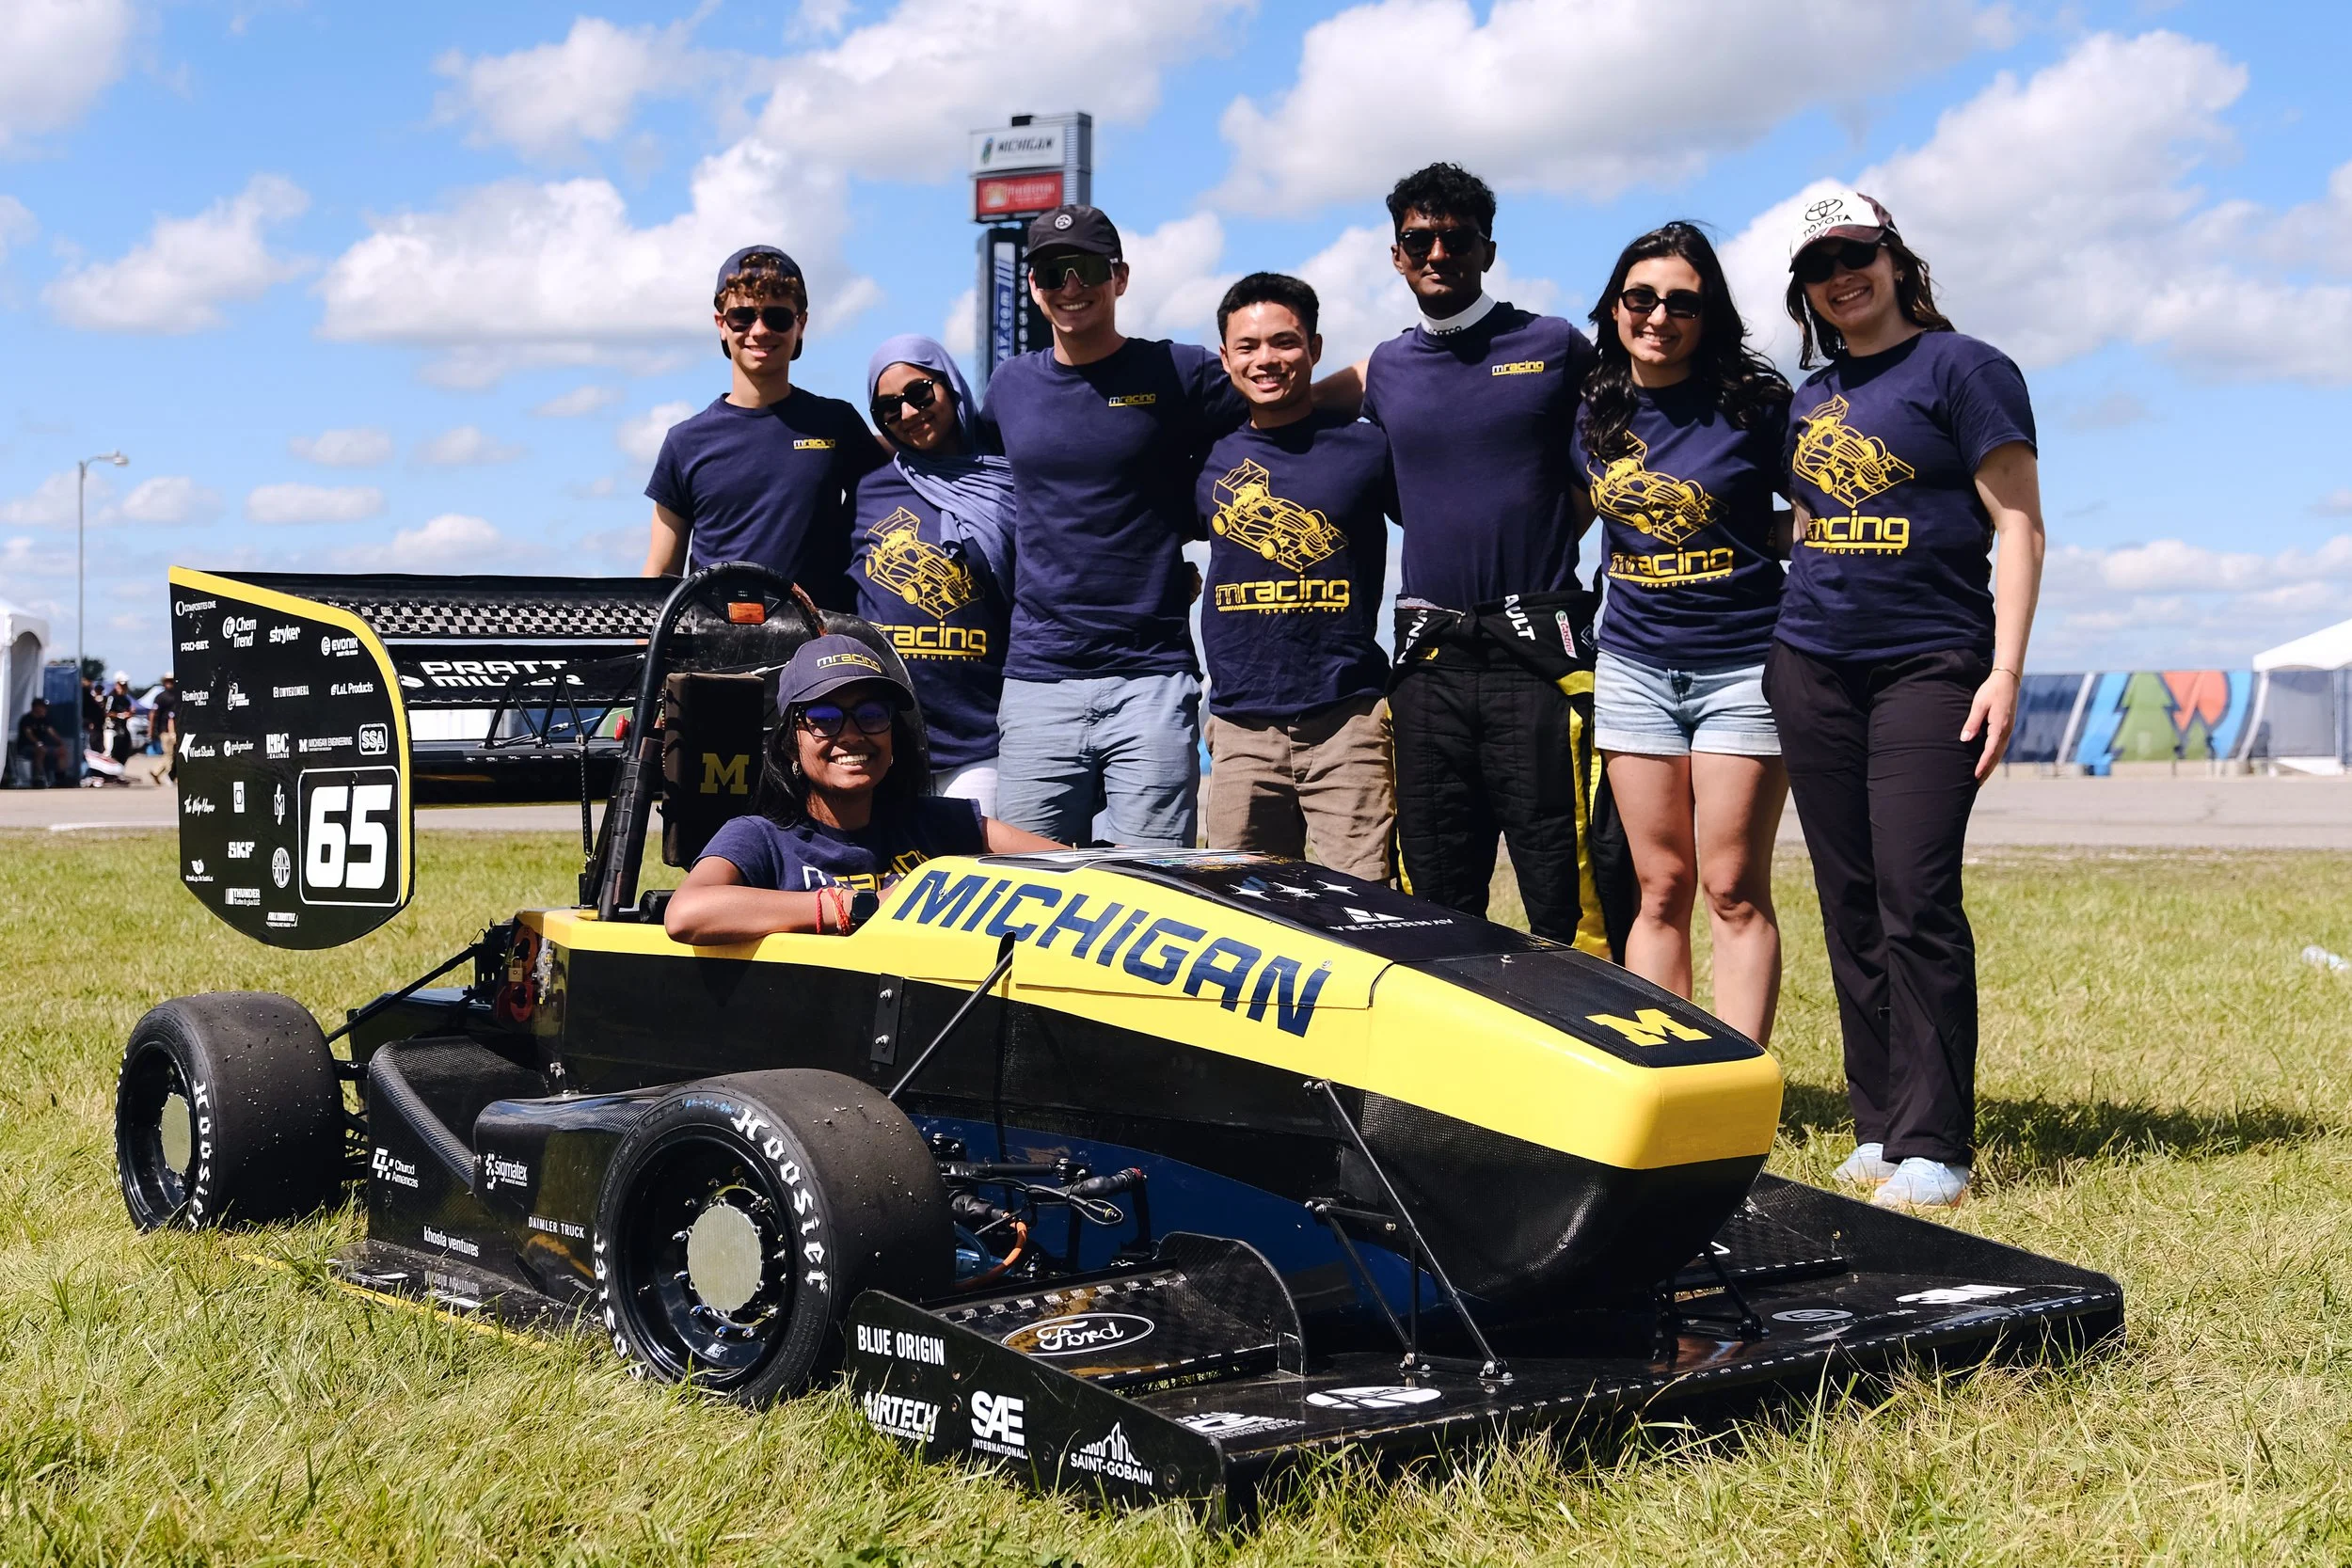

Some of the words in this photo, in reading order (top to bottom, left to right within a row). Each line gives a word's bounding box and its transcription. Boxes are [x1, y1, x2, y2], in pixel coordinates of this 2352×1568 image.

[1804, 214, 1852, 237] TOYOTA
[1019, 293, 1027, 309] 4
[1492, 360, 1545, 375] mracing
[1108, 393, 1156, 406] mracing
[1216, 574, 1350, 611] mracing
[236, 616, 257, 632] Chem
[269, 625, 301, 644] stryker
[232, 631, 254, 648] Trend
[420, 660, 567, 676] PRATT
[817, 653, 882, 673] mracing
[348, 682, 374, 694] Products
[361, 730, 385, 750] SSA
[699, 752, 750, 795] M
[306, 784, 393, 889] 65
[228, 841, 255, 859] SKF
[233, 888, 261, 898] THUNDER
[892, 870, 1331, 1037] MICHIGAN
[1585, 1008, 1712, 1047] M
[494, 1155, 528, 1182] sigmatex
[730, 1107, 828, 1293] Hoosier
[528, 1216, 558, 1233] DAIMLER
[560, 1223, 585, 1240] TRUCK
[423, 1226, 447, 1250] khosla
[448, 1235, 480, 1258] ventures
[857, 1324, 893, 1356] BLUE
[896, 1332, 946, 1366] ORIGIN
[1036, 1321, 1124, 1351] Ford
[864, 1391, 941, 1434] AIRTECH
[971, 1390, 1025, 1447] SAE
[972, 1438, 1027, 1460] INTERNATIONAL
[1071, 1452, 1153, 1486] SAINT-GOBAIN
